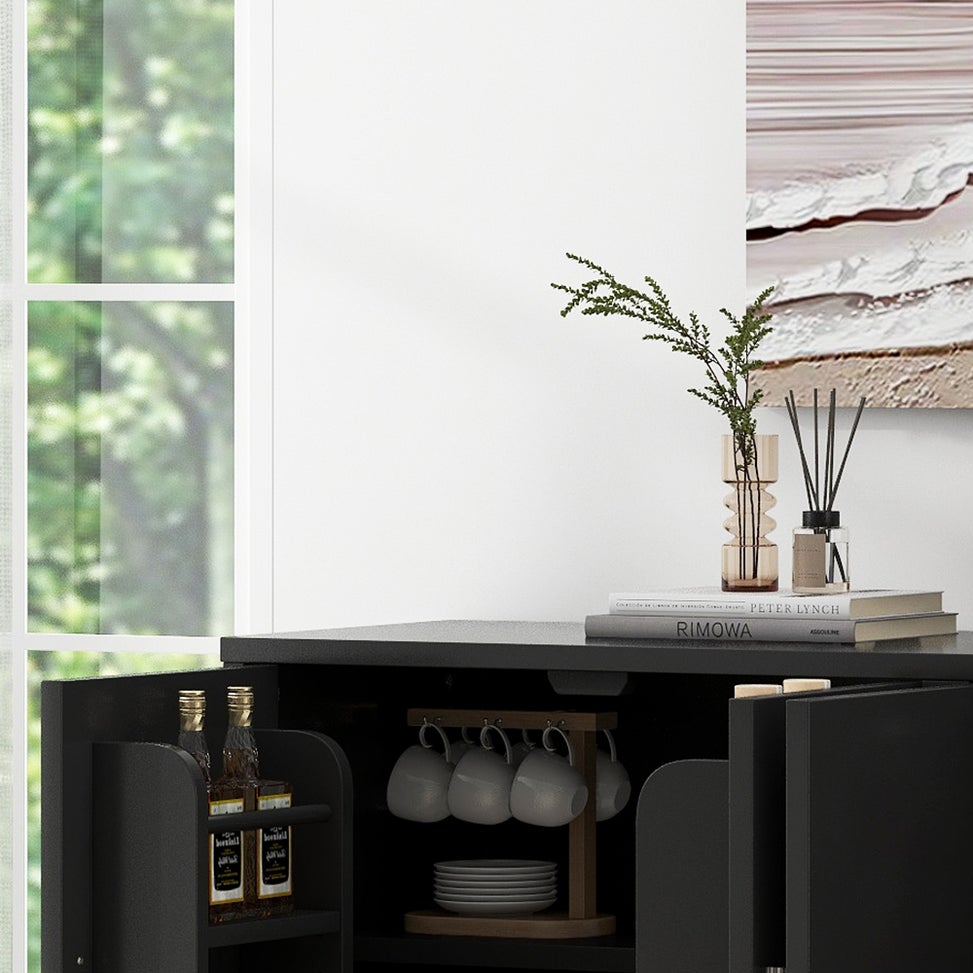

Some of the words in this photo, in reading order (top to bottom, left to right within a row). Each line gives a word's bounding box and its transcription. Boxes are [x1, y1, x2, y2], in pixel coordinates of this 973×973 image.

[750, 603, 792, 613] PETER
[797, 604, 840, 615] LYNCH
[676, 621, 753, 639] RIMOWA
